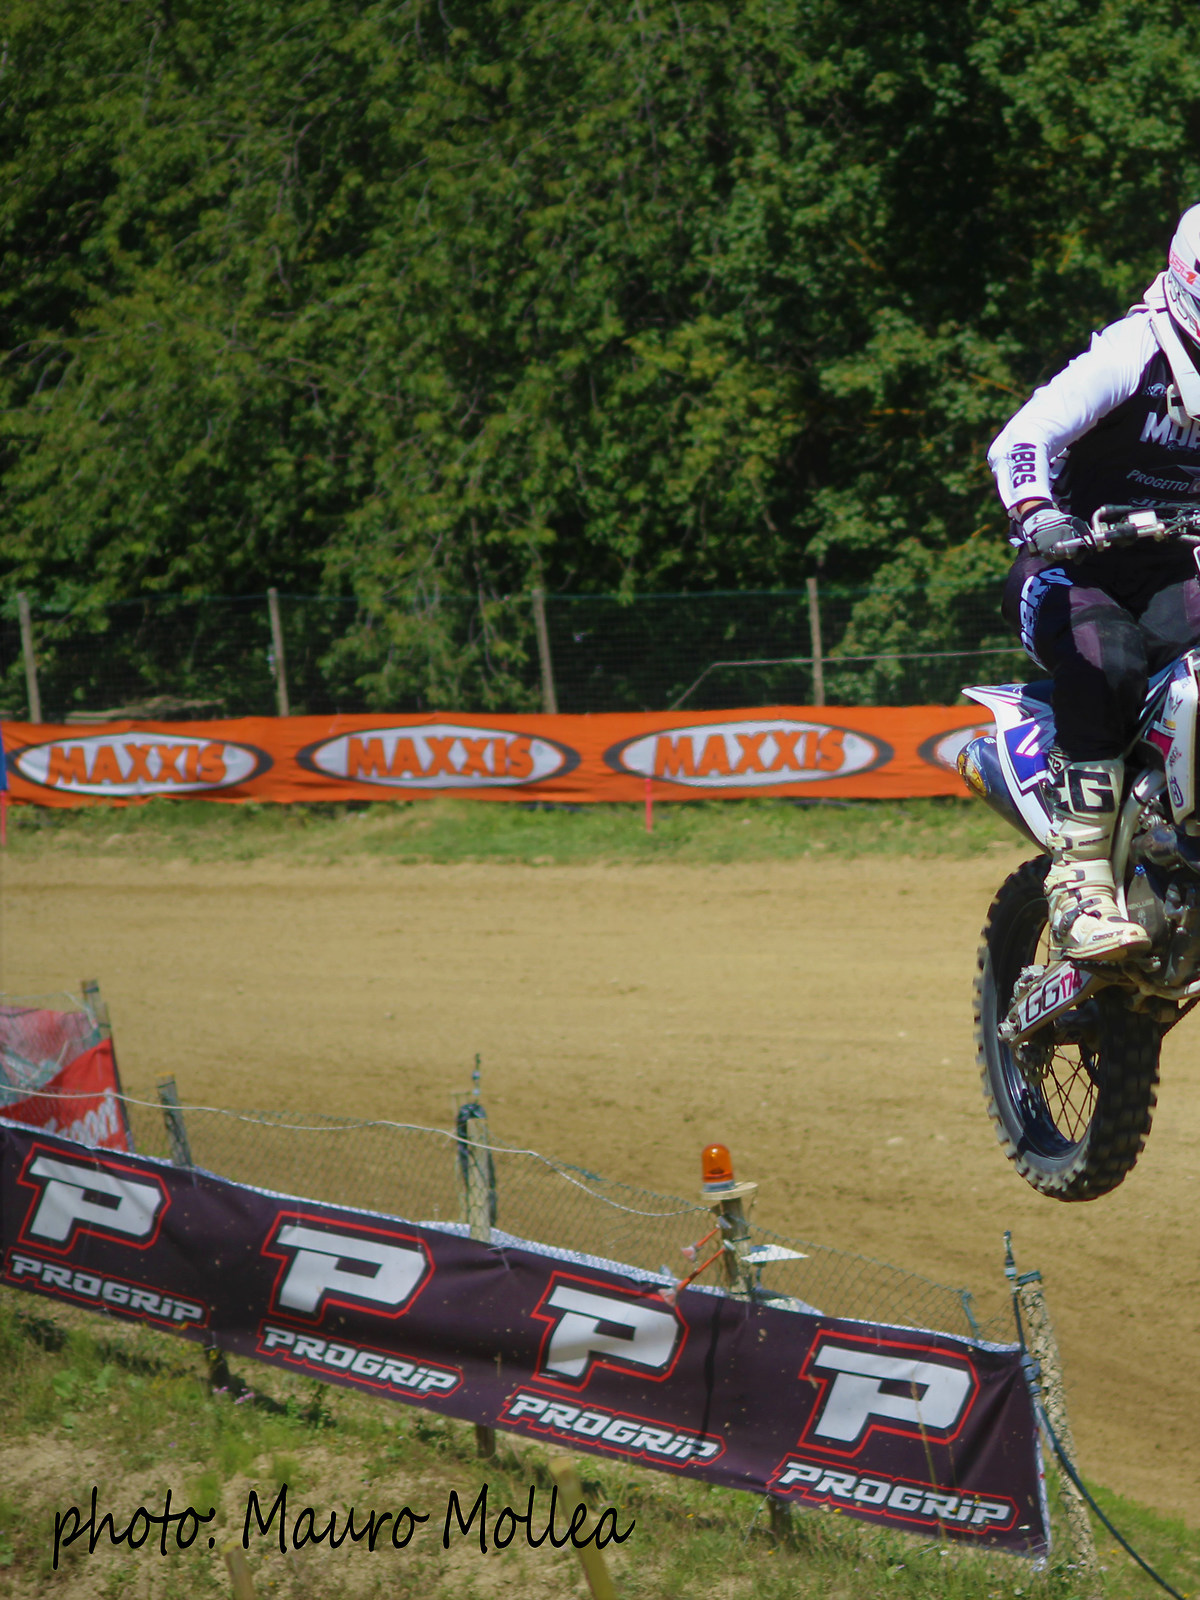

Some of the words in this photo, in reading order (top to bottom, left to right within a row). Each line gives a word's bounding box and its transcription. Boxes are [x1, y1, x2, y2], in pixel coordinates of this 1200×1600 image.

[1126, 470, 1190, 492] PROGETTO
[46, 743, 226, 785] MAXXIS
[348, 736, 534, 778] MAXXIS
[653, 730, 846, 777] MAXXIS
[30, 1156, 161, 1242] P
[277, 1225, 426, 1313] P
[547, 1286, 679, 1377] P
[814, 1345, 971, 1442] P
